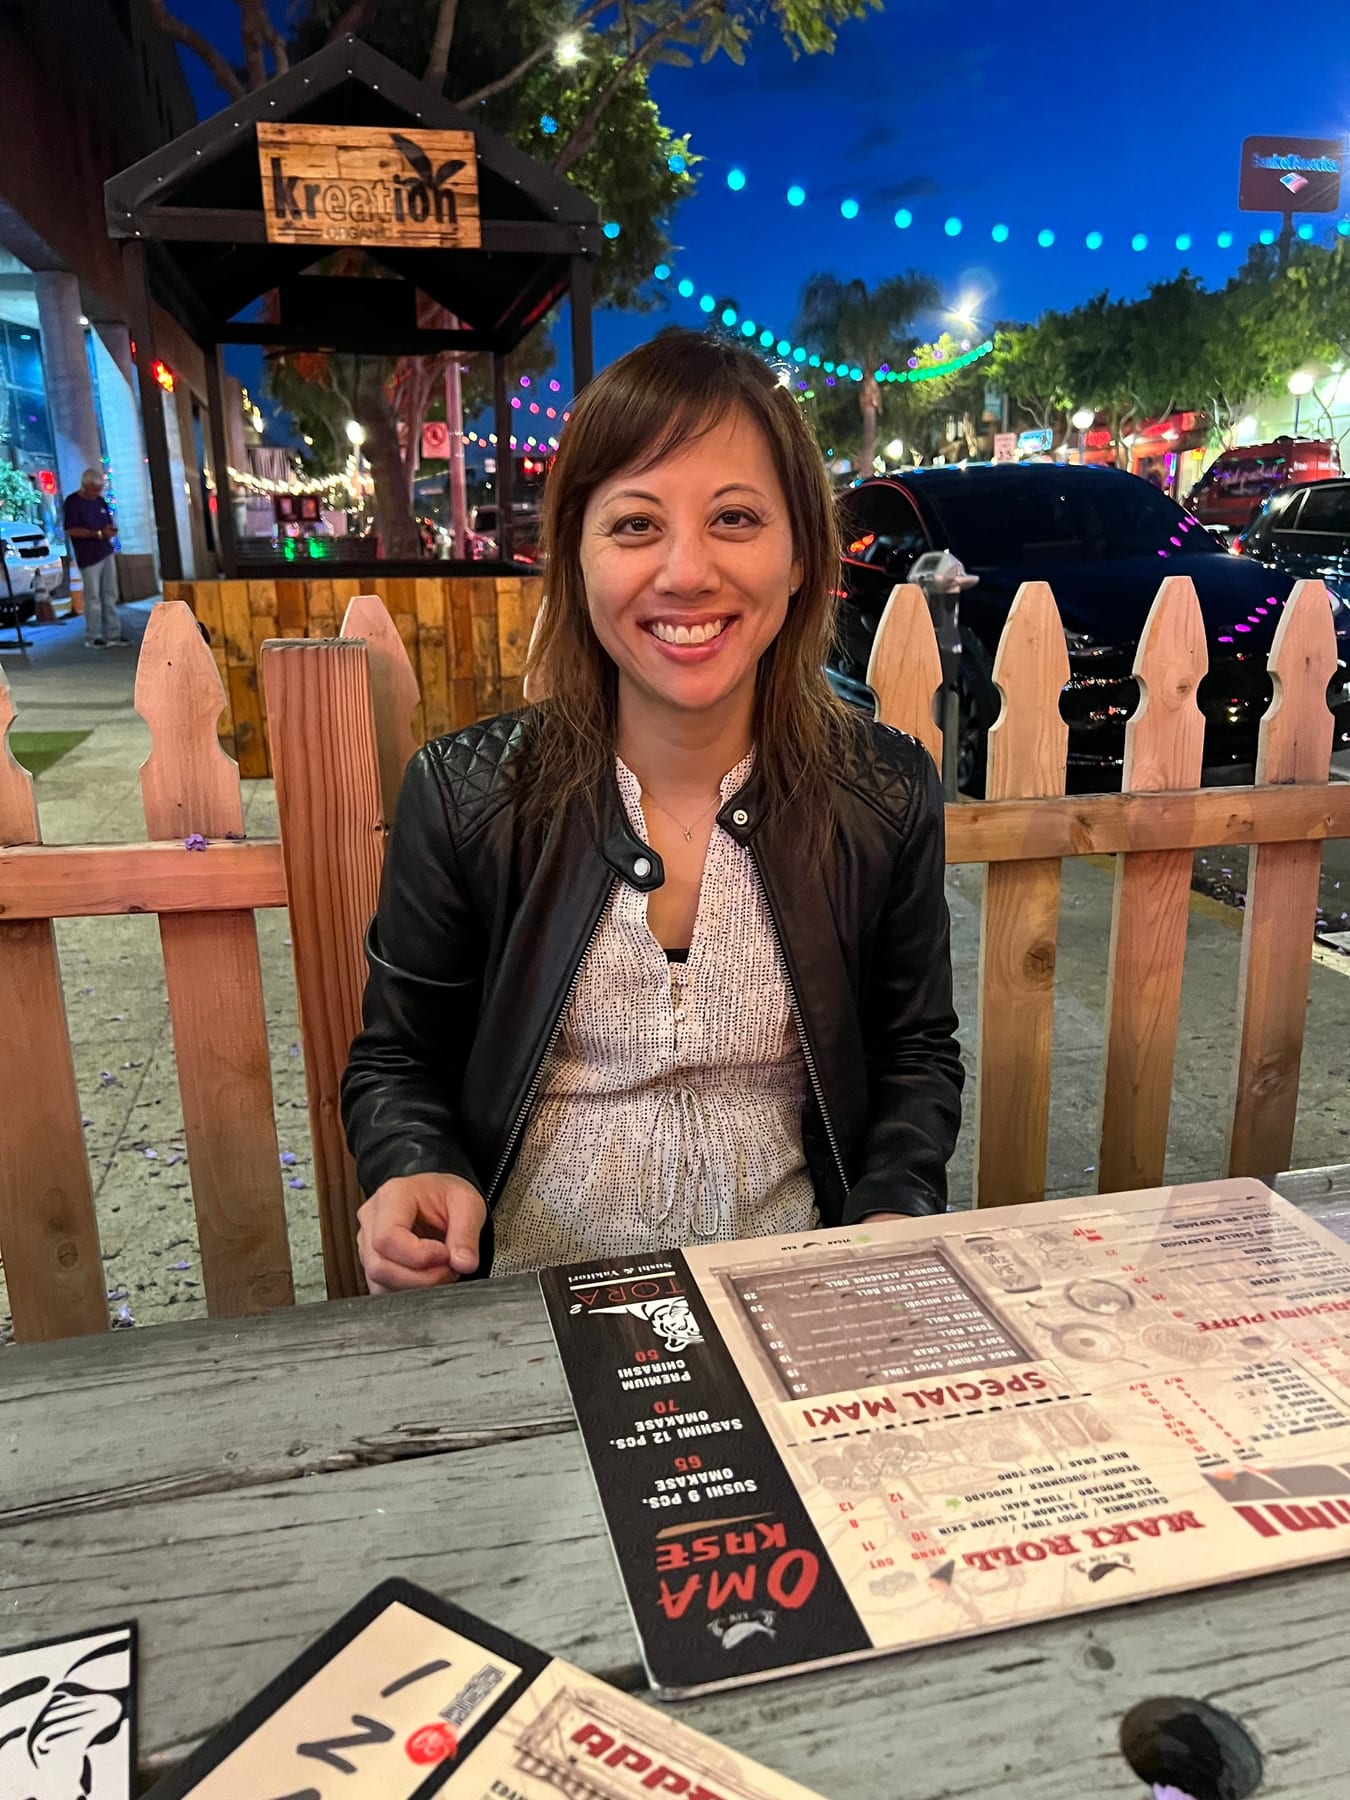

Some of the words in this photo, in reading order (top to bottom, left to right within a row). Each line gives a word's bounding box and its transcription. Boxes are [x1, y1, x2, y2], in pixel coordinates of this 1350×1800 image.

[271, 157, 456, 223] kreation
[638, 1262, 672, 1273] Sushi
[568, 1269, 620, 1283] Yakitori
[916, 1276, 955, 1288] SALMON
[825, 1279, 850, 1288] ROLL
[882, 1282, 913, 1292] LOVER
[573, 1278, 686, 1306] TORA
[854, 1287, 881, 1296] ROLL
[924, 1315, 951, 1325] ROLL
[1195, 1312, 1266, 1332] PLATE
[937, 1327, 965, 1337] ROLL
[966, 1322, 994, 1333] TORA
[942, 1340, 976, 1351] SHELL
[979, 1335, 1005, 1346] SOFT
[634, 1349, 659, 1362] 50
[913, 1346, 941, 1357] CRAB
[987, 1349, 1017, 1360] ROCK
[913, 1361, 943, 1372] SPICY
[947, 1354, 986, 1367] SHRIMP
[617, 1359, 686, 1378] CHIRASHI
[881, 1366, 911, 1377] TUNA
[621, 1371, 691, 1391] PREMIUM
[792, 1383, 808, 1393] 20
[903, 1372, 1047, 1409] SPECIAL
[652, 1400, 679, 1414] 70
[802, 1396, 897, 1428] MAKI
[634, 1410, 709, 1432] OMAKASE
[676, 1418, 743, 1439] SASHIMI
[609, 1436, 647, 1449] PCS.
[652, 1431, 672, 1444] 12
[674, 1455, 702, 1471] 65
[1068, 1457, 1097, 1467] CRAB
[1101, 1451, 1129, 1462] BLUE
[1101, 1465, 1140, 1476] VEGGIE
[654, 1468, 733, 1491] OMAKASE
[1028, 1474, 1088, 1490] CUCUMBER
[705, 1479, 757, 1499] SUSHI
[964, 1488, 1013, 1503] AVOCADO
[1078, 1482, 1126, 1496] AVOCADO
[1091, 1487, 1160, 1504] YELLOWTAIL
[642, 1492, 682, 1509] PCS.
[688, 1490, 699, 1503] 9
[1033, 1494, 1064, 1505] TUNA
[1001, 1500, 1030, 1511] MAKI
[1031, 1503, 1078, 1517] SALMON
[1102, 1497, 1168, 1514] CALIFORNIA
[971, 1515, 1017, 1528] SALMON
[1056, 1512, 1089, 1523] SPICY
[938, 1524, 966, 1535] SKIN
[1022, 1519, 1052, 1530] TUNA
[1082, 1511, 1206, 1548] MAKI
[656, 1522, 788, 1571] KASE
[961, 1534, 1081, 1572] ROLL
[656, 1549, 820, 1620] OMA
